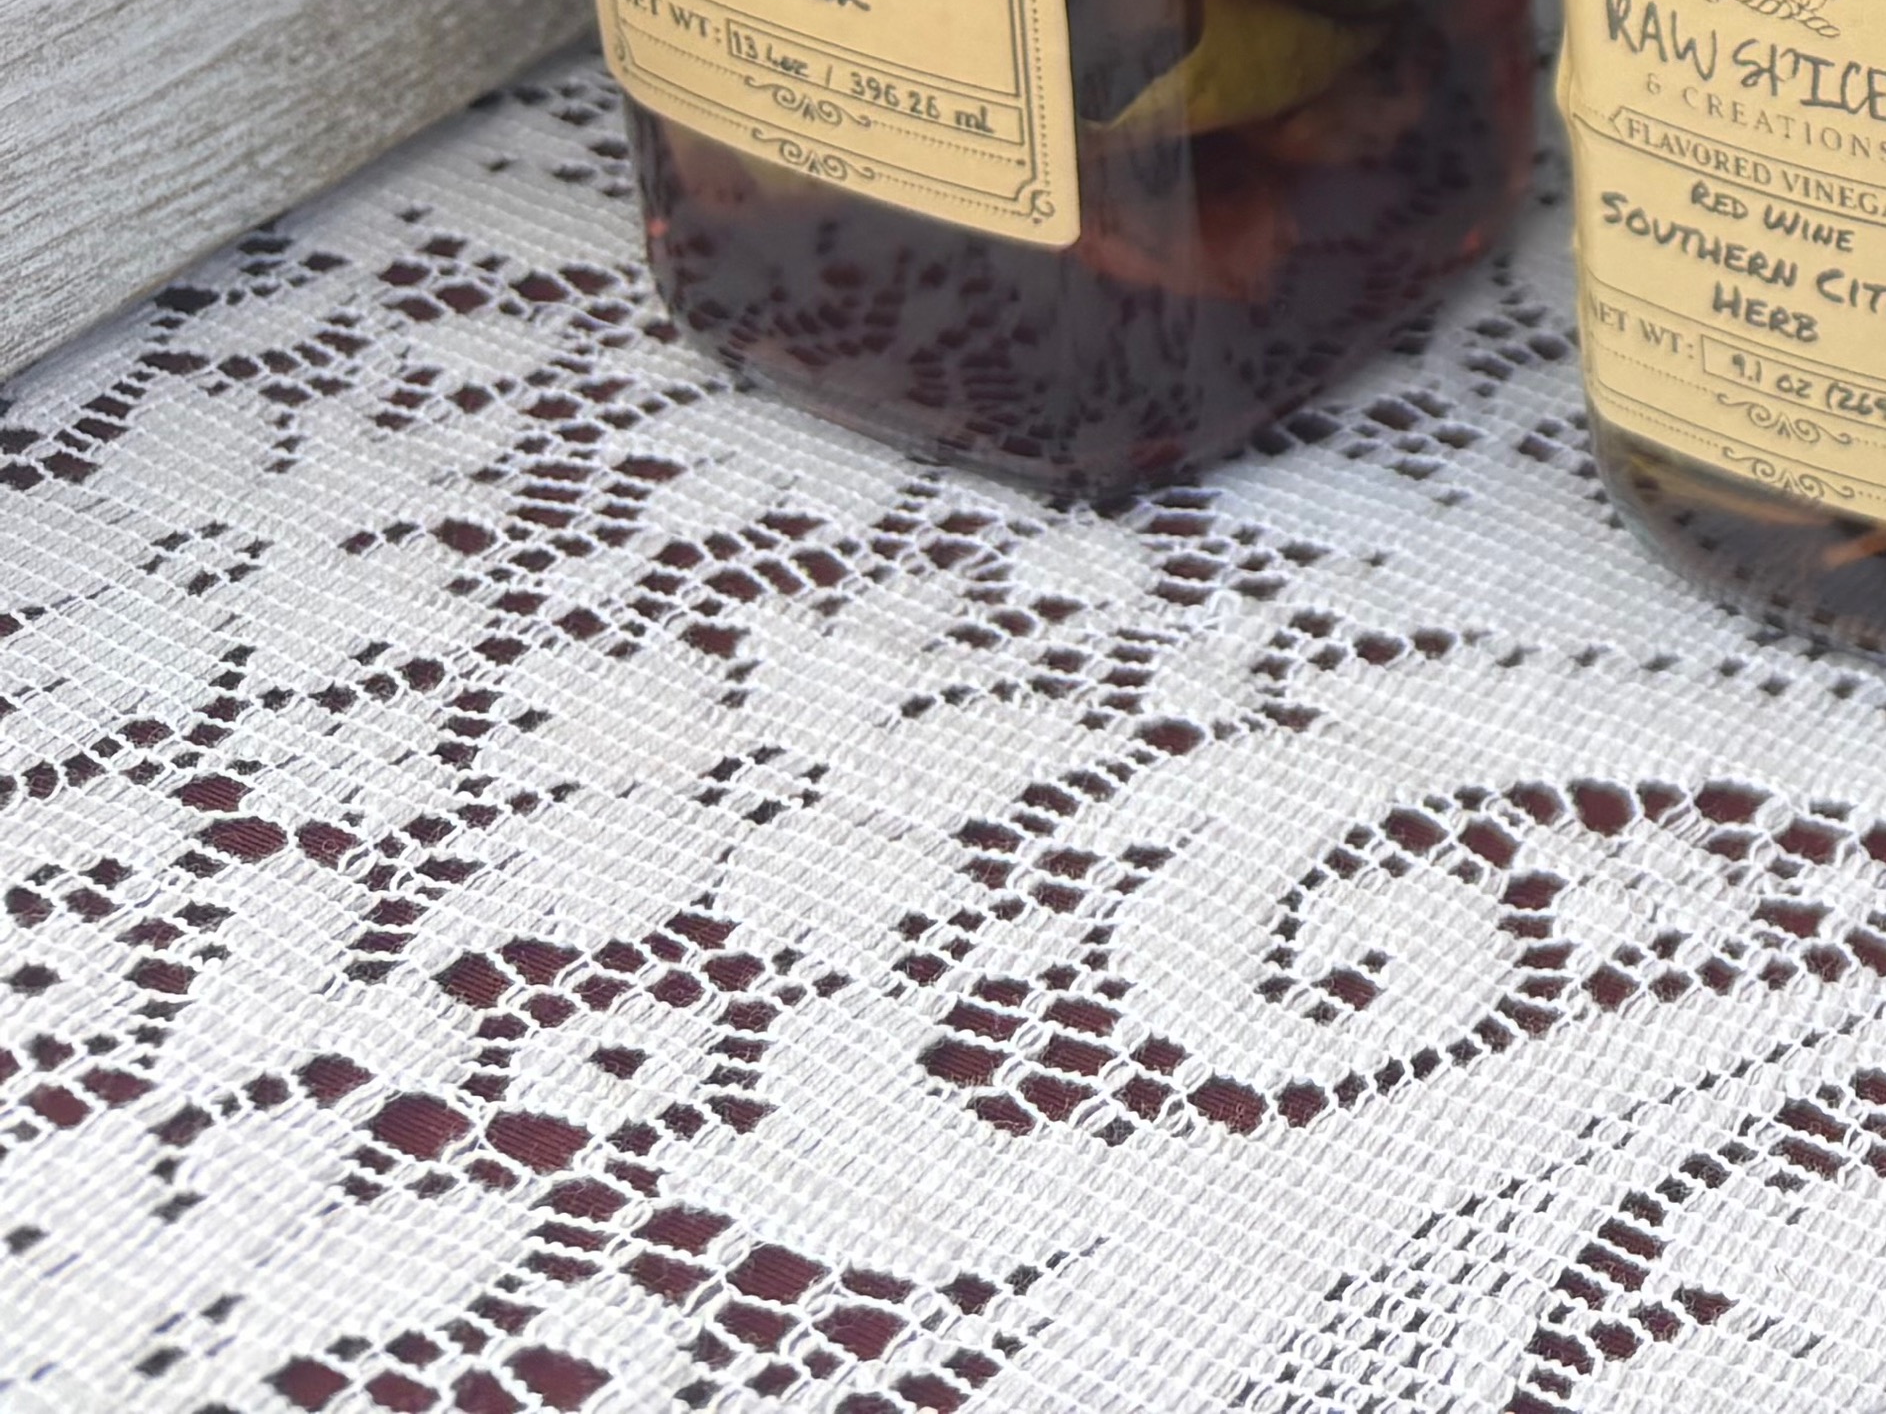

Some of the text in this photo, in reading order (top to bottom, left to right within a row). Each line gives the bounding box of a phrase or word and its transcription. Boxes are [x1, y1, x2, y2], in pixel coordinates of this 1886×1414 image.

[669, 3, 722, 46] WT:
[1646, 72, 1661, 95] &
[1627, 119, 1772, 187] FLAVORED
[1600, 190, 1799, 289] SOUTHERN
[1691, 179, 1855, 252] RED WINE
[1639, 318, 1695, 359] WT:
[1712, 281, 1820, 343] HERB
